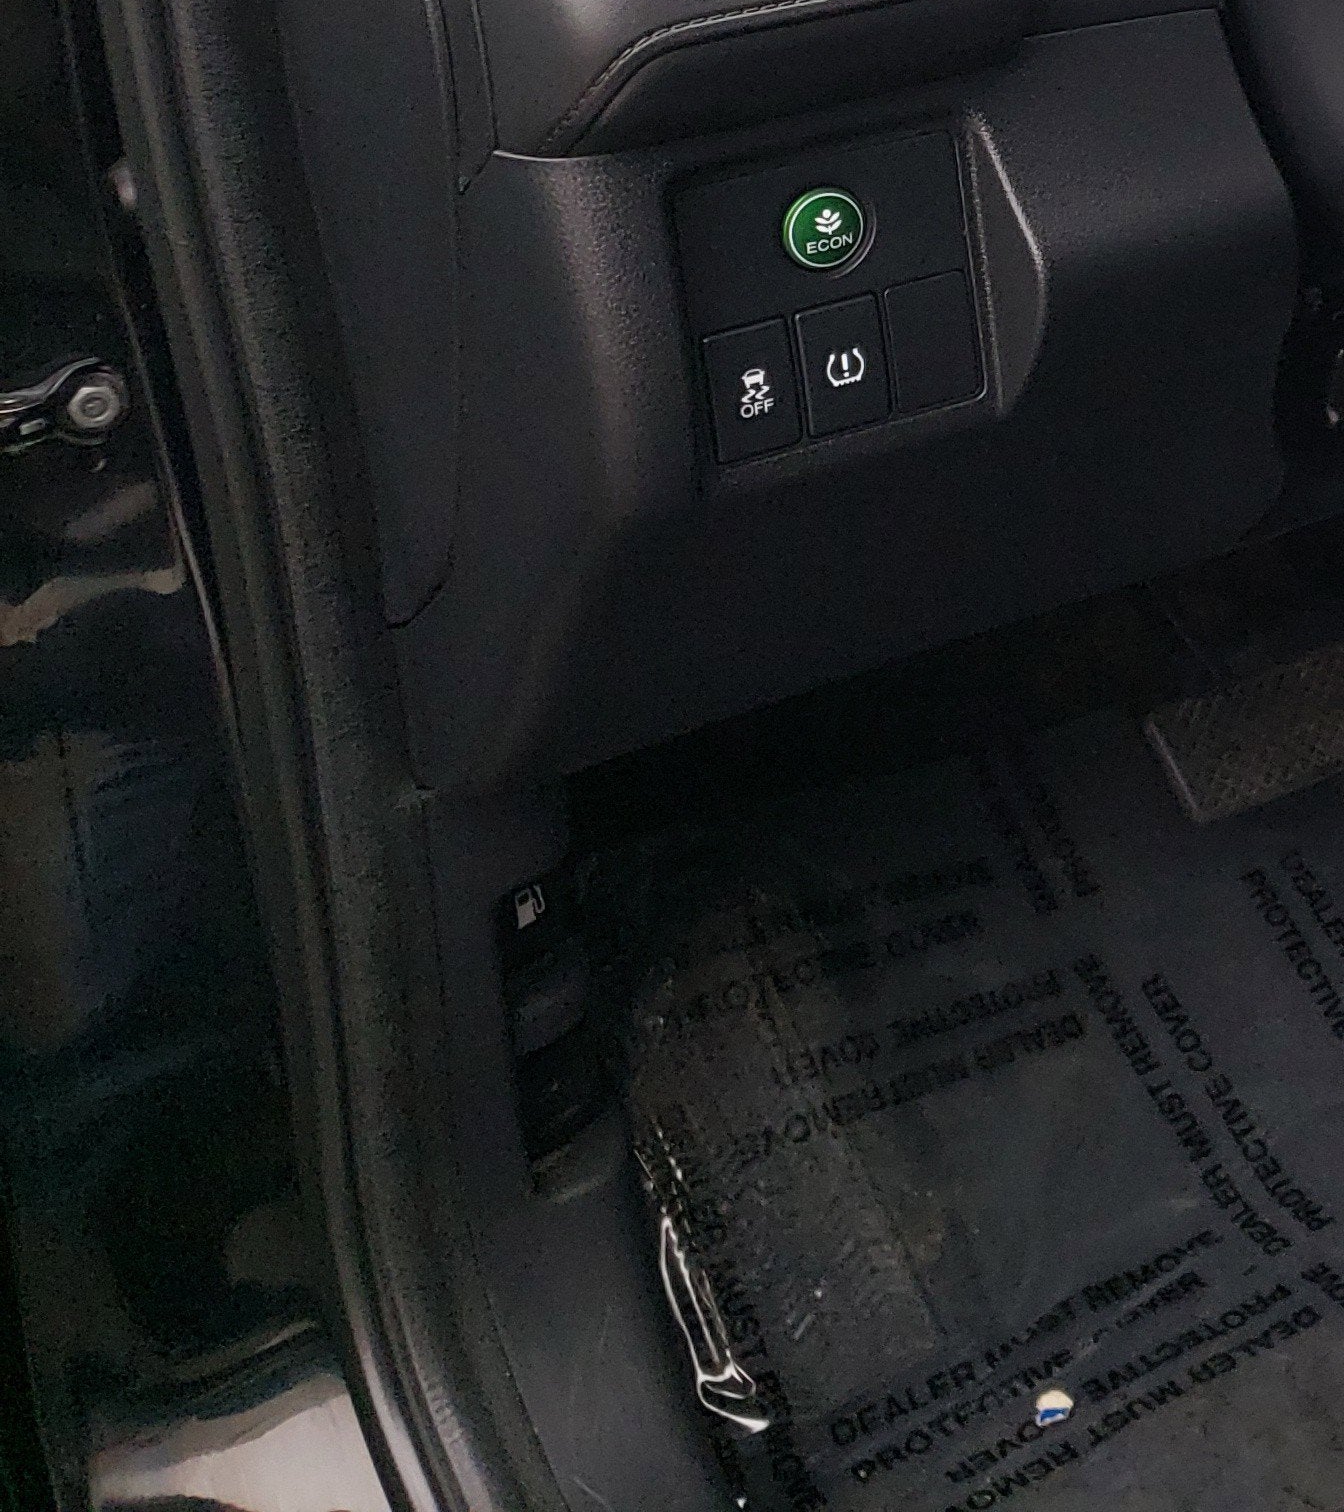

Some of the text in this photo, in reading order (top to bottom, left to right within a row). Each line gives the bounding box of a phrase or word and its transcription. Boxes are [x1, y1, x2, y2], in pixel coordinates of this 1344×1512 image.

[806, 233, 853, 255] ECON
[740, 398, 774, 419] OFF
[1070, 950, 1291, 1258] DEALER MUST REMOVE
[1139, 970, 1335, 1233] PROTECTIVE COVER
[945, 1281, 1291, 1487] PROTECTIVE OVER
[1187, 1302, 1321, 1386] DEALER
[825, 1358, 978, 1450] DEALER
[1086, 1378, 1183, 1447] MUST
